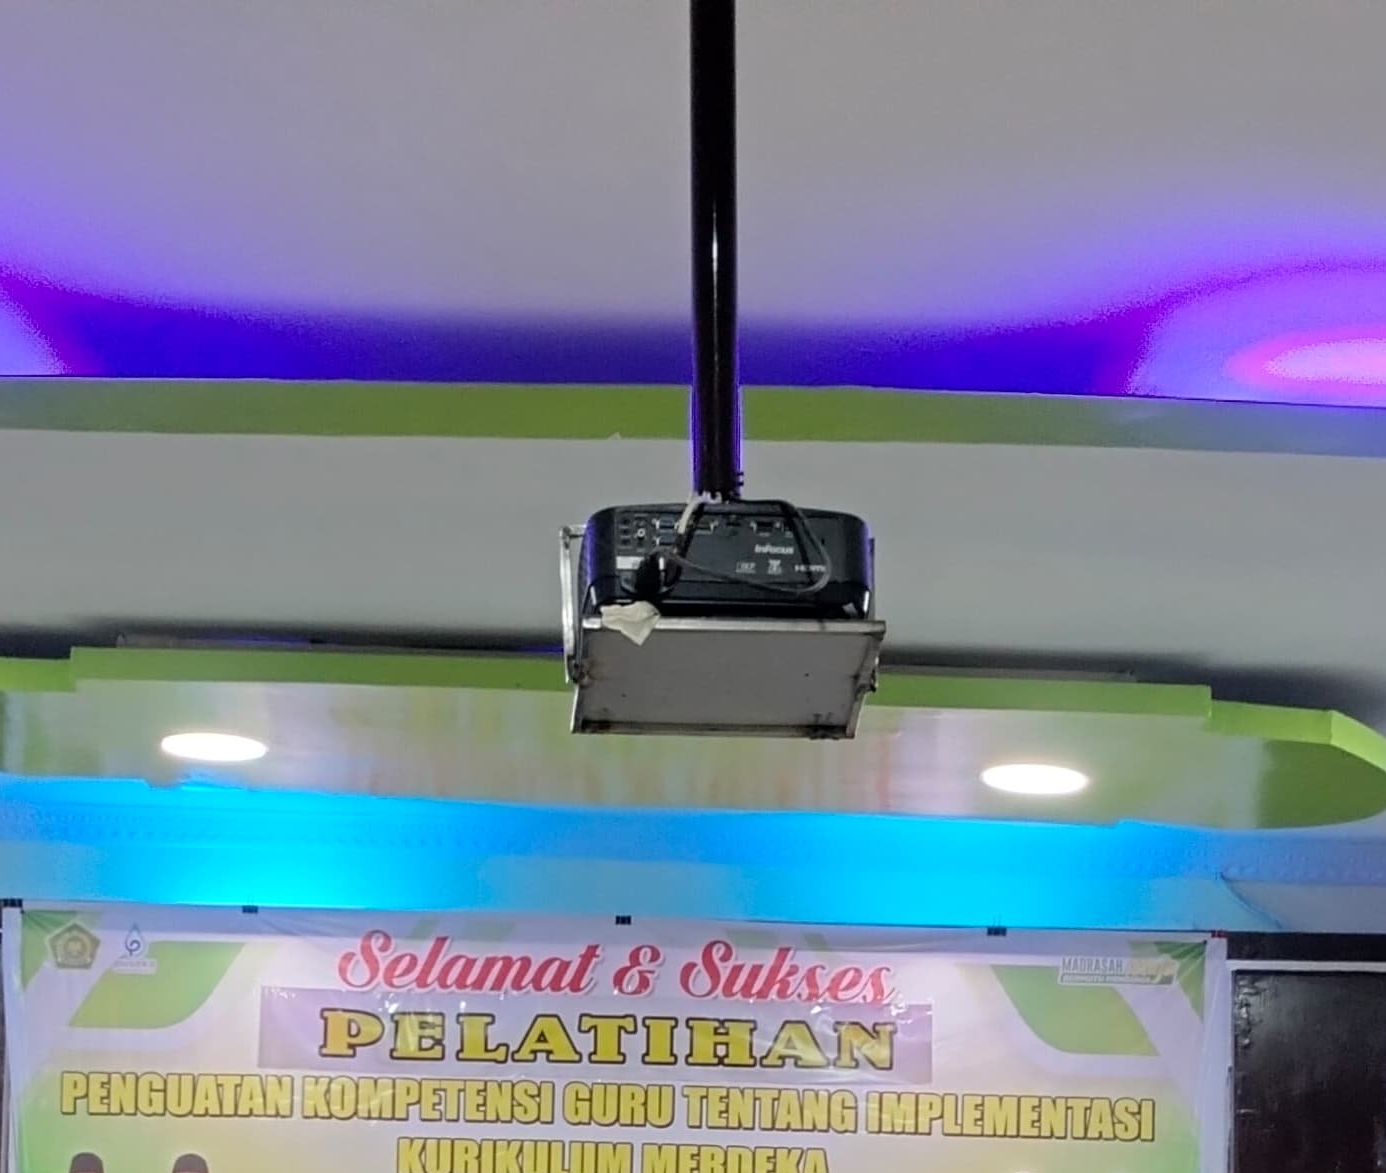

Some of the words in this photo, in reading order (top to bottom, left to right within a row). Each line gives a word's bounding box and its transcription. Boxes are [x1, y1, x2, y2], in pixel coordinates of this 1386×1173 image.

[338, 929, 601, 994] Selamat
[612, 944, 661, 996] &
[679, 939, 895, 1006] Sukses
[319, 1007, 897, 1070] PELATIHAN
[60, 1071, 294, 1119] PENGUATAN
[302, 1075, 555, 1126] KOMPETENSI
[562, 1082, 675, 1129] GURU
[683, 1085, 858, 1135] TENTANG
[865, 1091, 1156, 1143] IMPLEMENTASI
